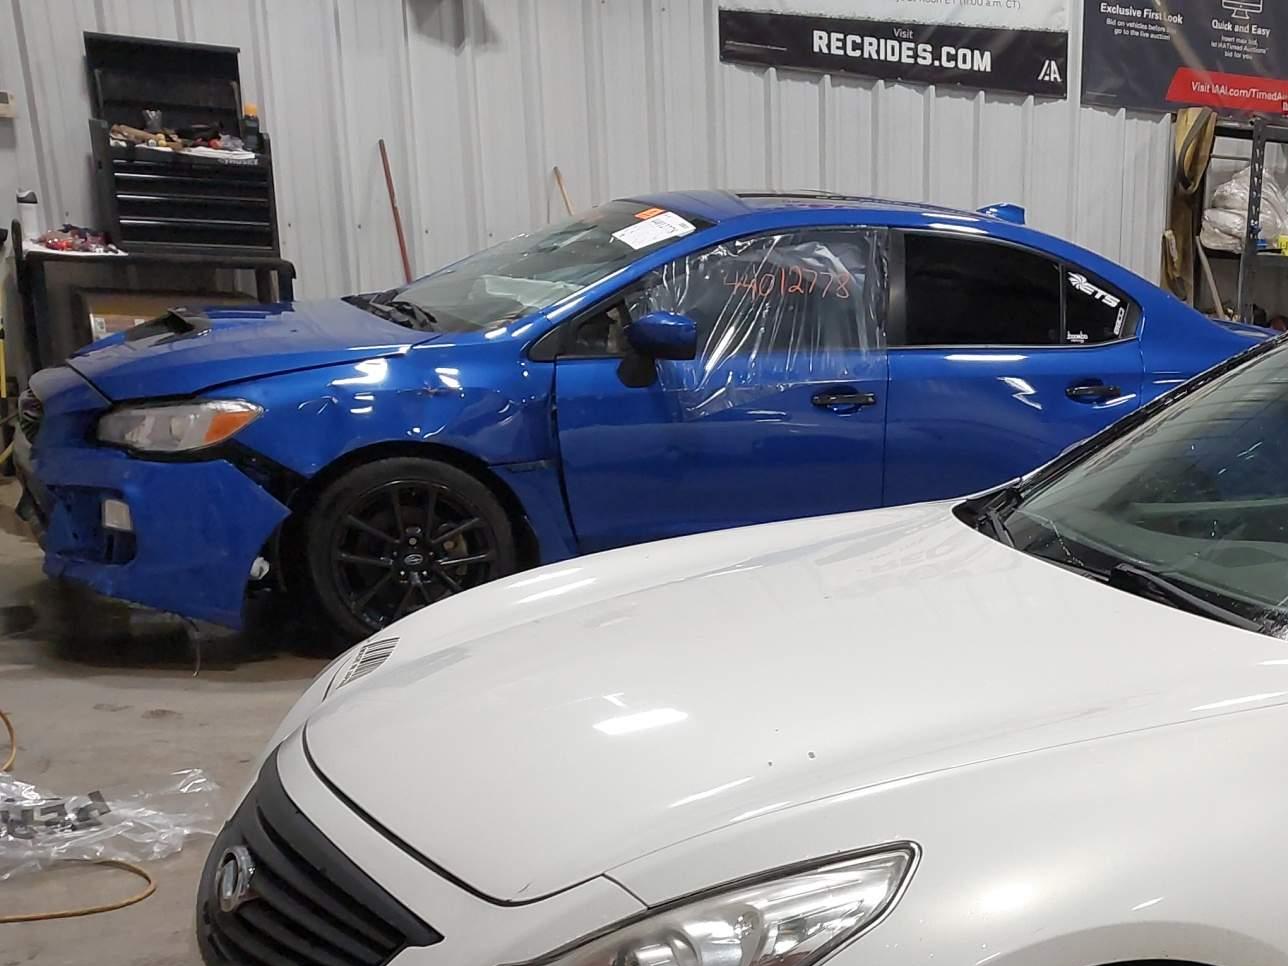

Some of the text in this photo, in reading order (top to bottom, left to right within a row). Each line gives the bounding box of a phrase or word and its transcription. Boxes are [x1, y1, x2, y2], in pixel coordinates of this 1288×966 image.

[1100, 3, 1142, 17] Exclusive
[1143, 8, 1162, 20] First
[893, 28, 913, 39] Visit
[1212, 19, 1270, 38] Quick and Easy
[812, 30, 991, 72] RECRIDES.COM
[1191, 81, 1211, 92] Visit
